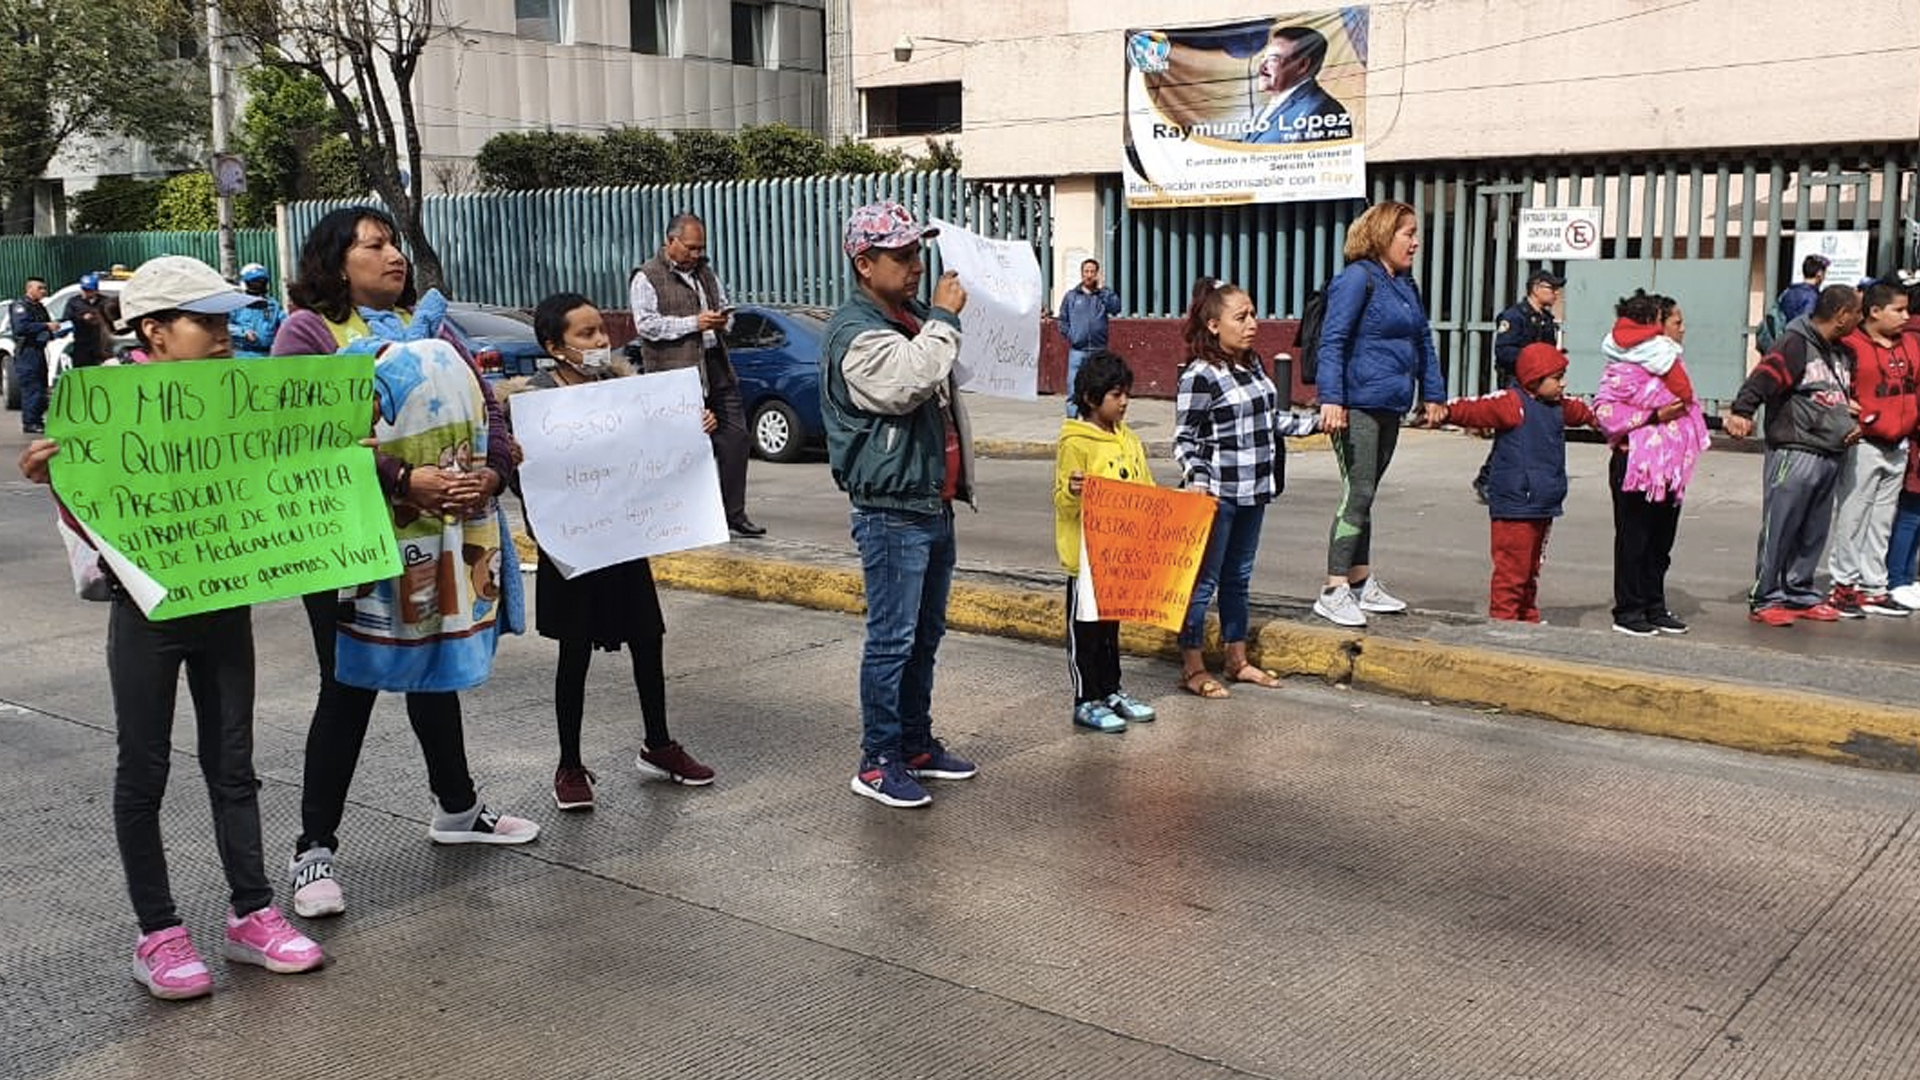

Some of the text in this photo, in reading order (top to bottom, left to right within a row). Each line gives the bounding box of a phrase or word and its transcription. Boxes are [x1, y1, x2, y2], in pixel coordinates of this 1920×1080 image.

[1153, 112, 1350, 141] Raymundo López
[1129, 171, 1354, 194] Renovación responsable con Ray
[55, 368, 374, 426] NO MAS DESABASTO
[63, 420, 354, 475] DE QUIMIOTERAPIAS
[110, 478, 252, 519] PRESIDENTE
[266, 463, 352, 496] CUMPLA
[143, 514, 230, 549] PROMESA
[240, 508, 268, 530] DE
[277, 500, 302, 521] NO
[310, 495, 347, 516] MAS
[159, 548, 187, 571] DE
[257, 555, 330, 591] queremos
